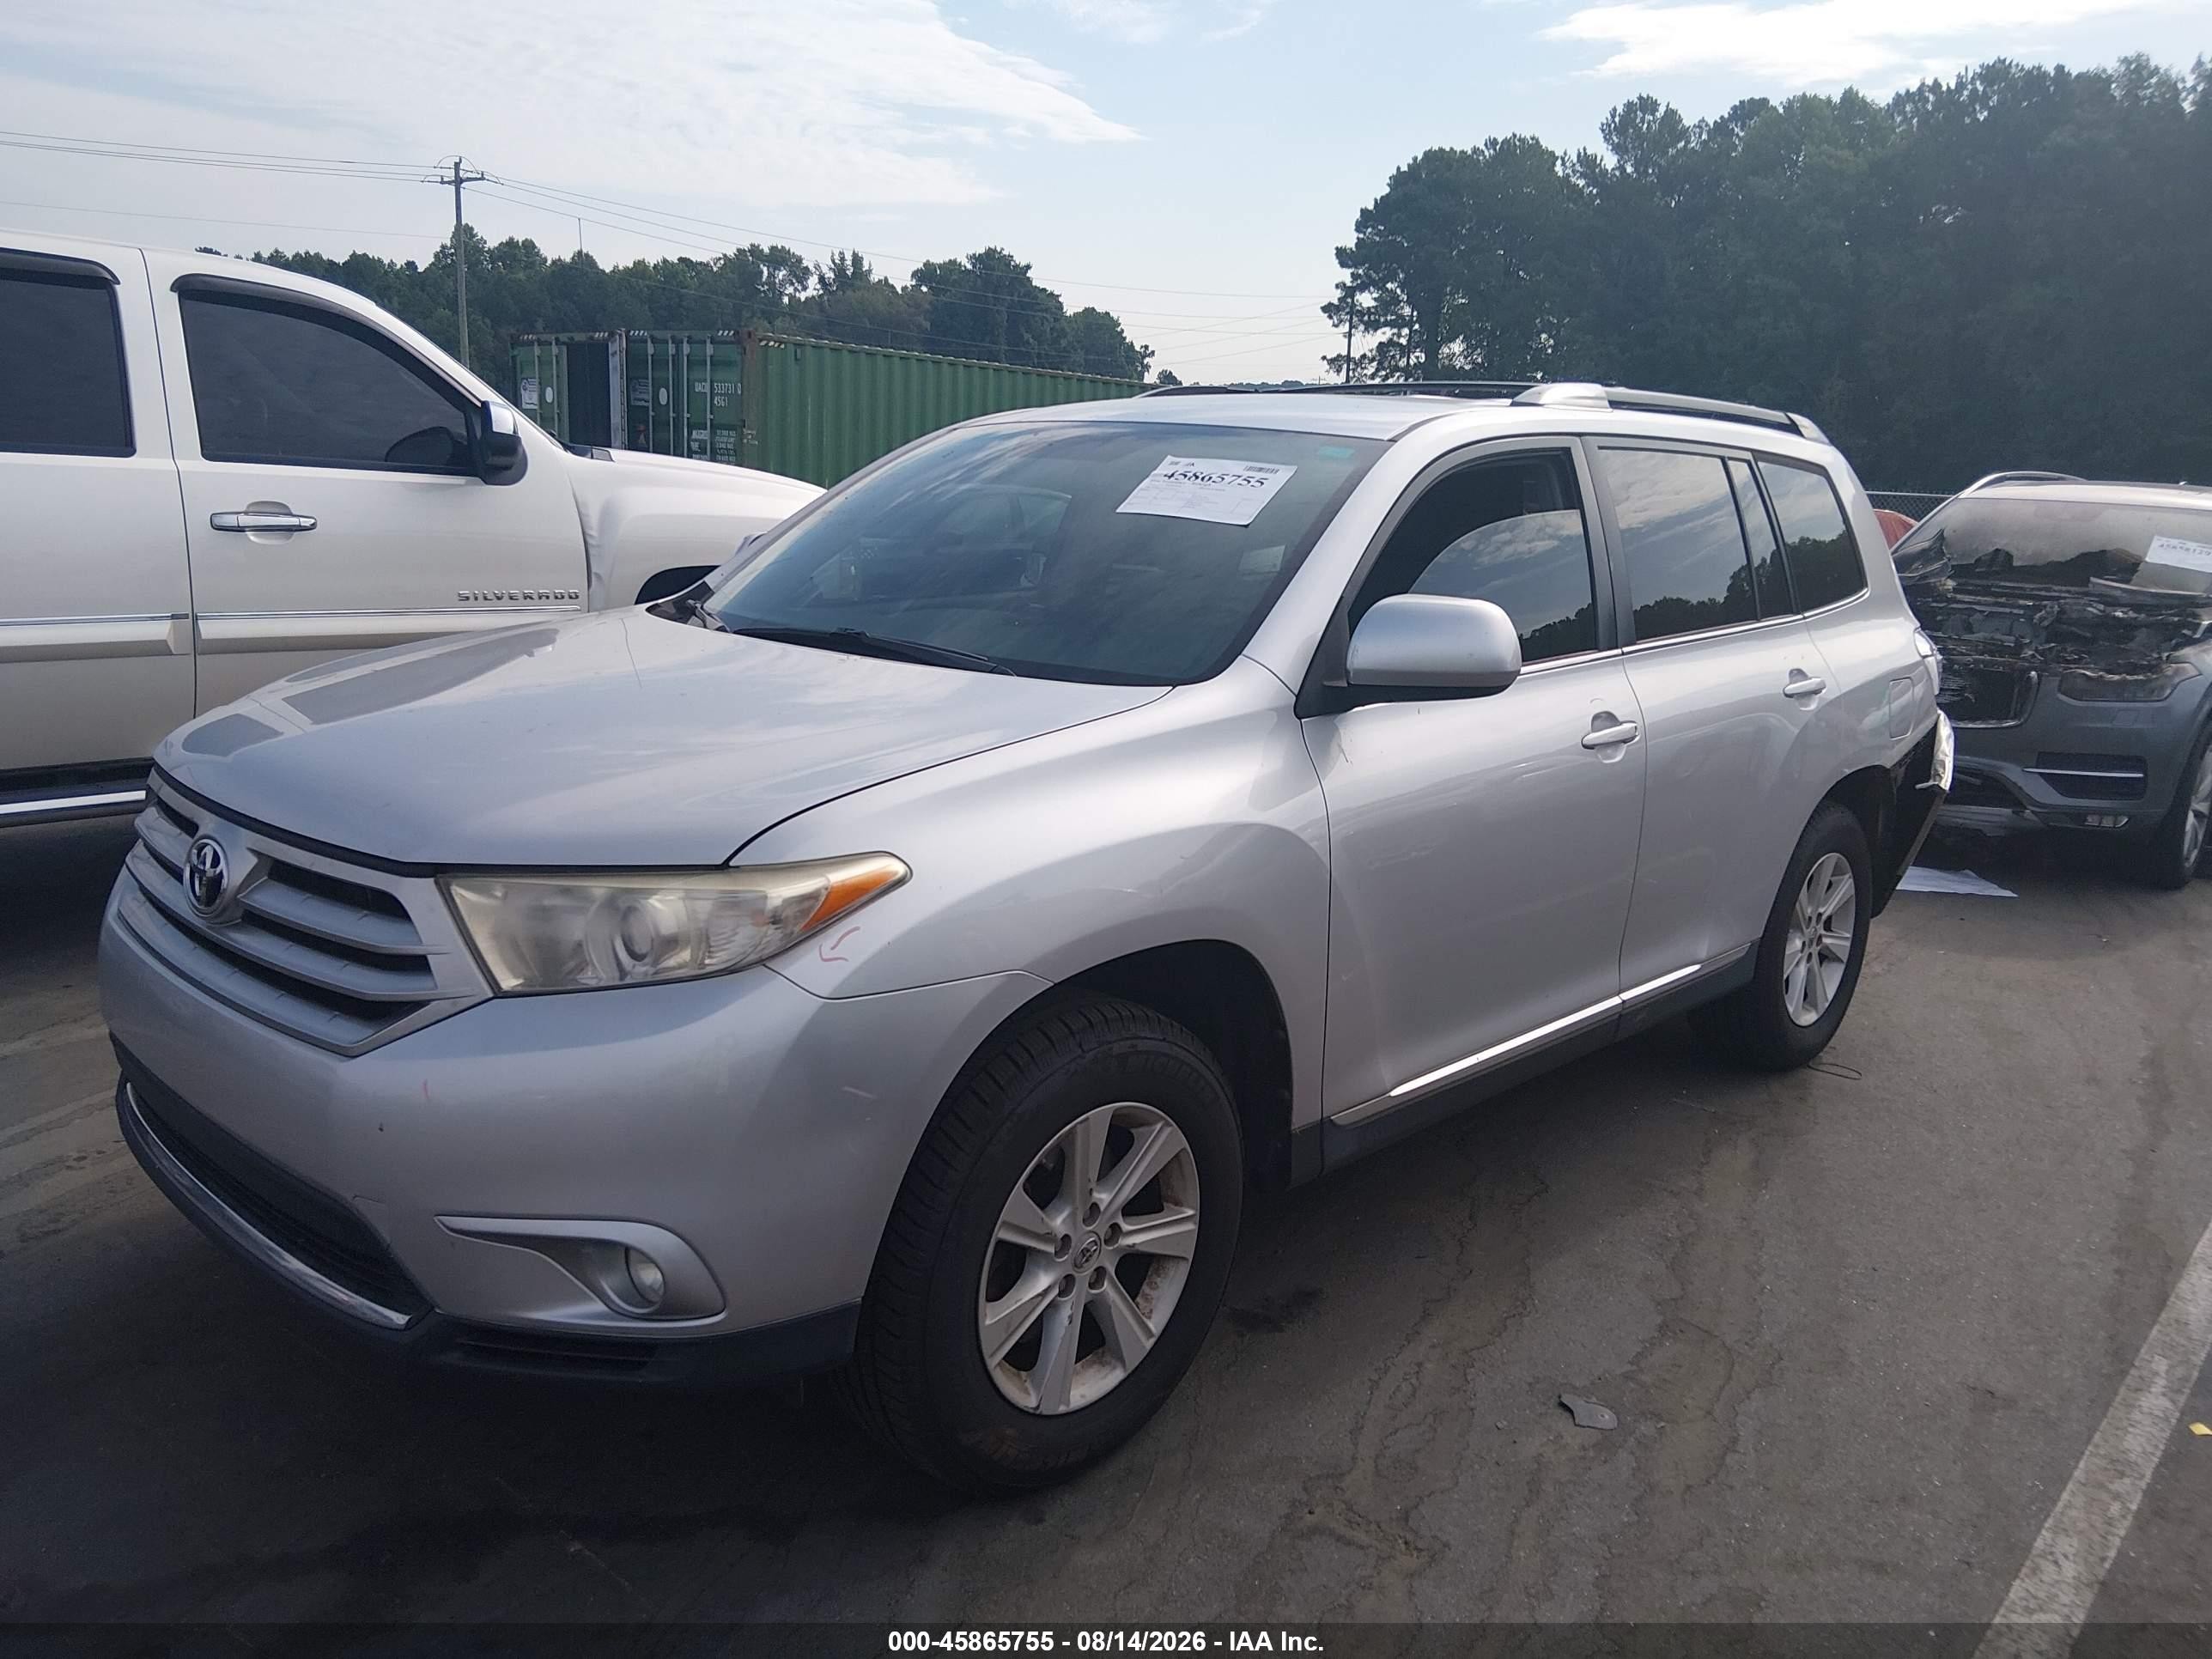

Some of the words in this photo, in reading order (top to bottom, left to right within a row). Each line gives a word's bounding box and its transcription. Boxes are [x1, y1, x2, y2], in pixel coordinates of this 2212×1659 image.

[714, 382, 734, 394] 533731
[1164, 470, 1270, 488] 45865755
[457, 590, 580, 602] SILVERADO
